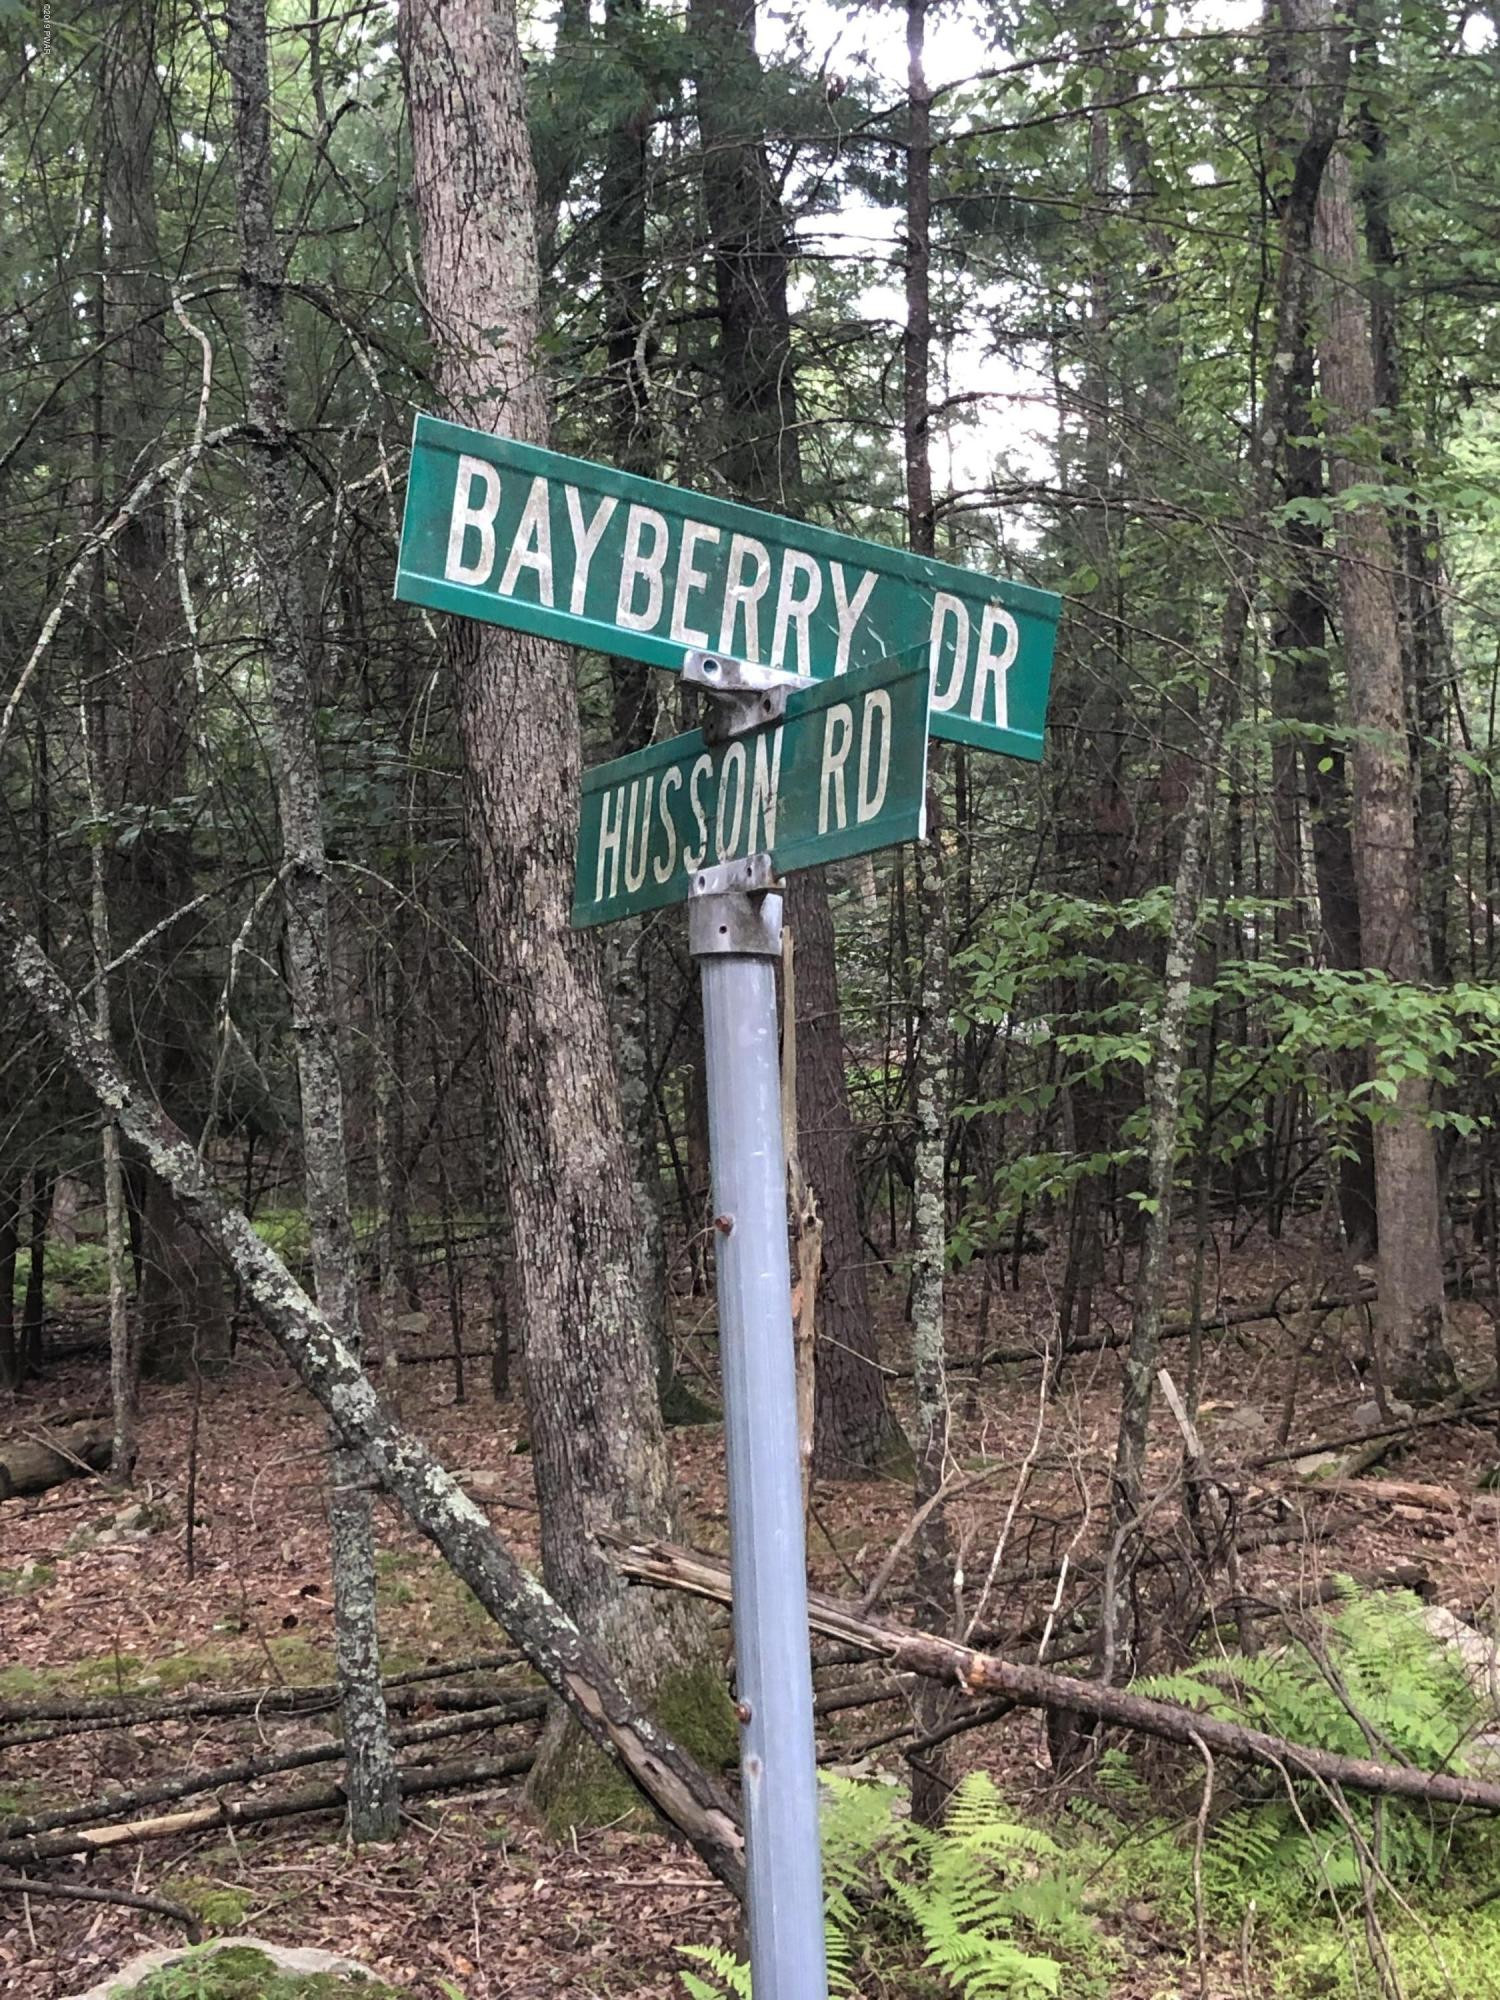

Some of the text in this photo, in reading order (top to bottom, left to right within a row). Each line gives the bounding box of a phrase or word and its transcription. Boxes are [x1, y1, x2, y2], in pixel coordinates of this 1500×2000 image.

[444, 454, 1019, 728] BAYBERRY DR
[595, 688, 893, 902] HUSSON RD
